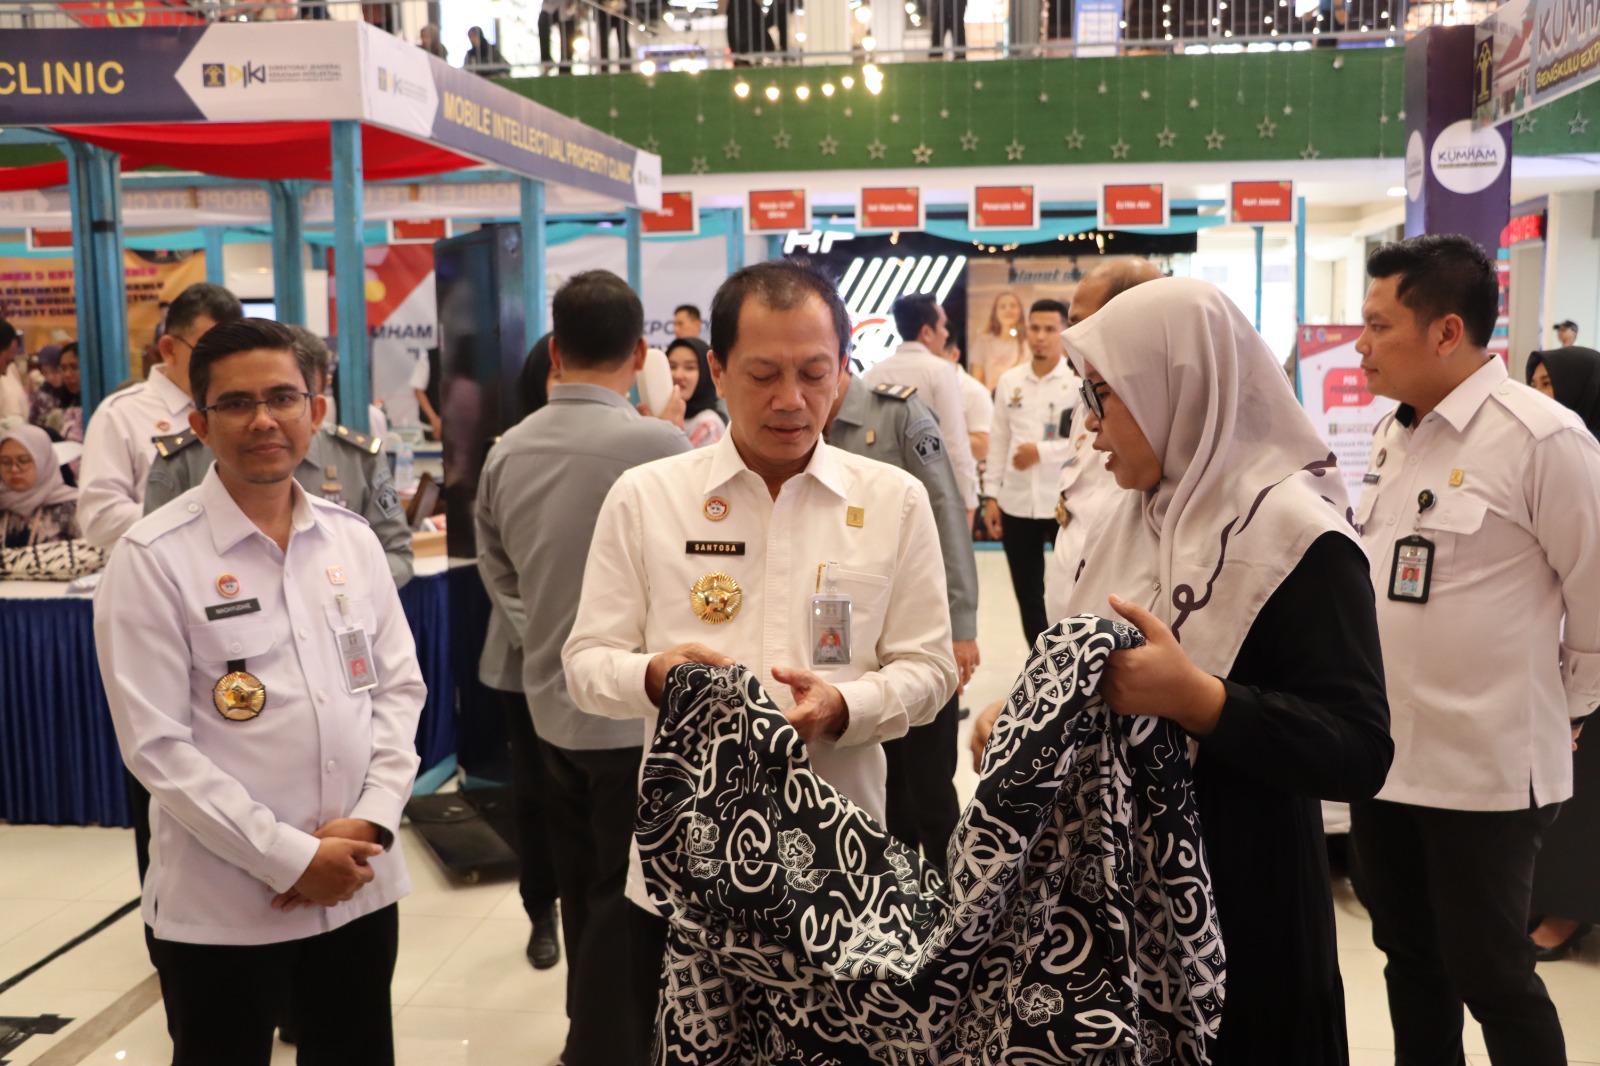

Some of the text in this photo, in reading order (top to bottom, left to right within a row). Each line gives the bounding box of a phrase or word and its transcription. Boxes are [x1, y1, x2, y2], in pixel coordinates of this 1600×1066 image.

[0, 61, 125, 95] CLINIC
[1536, 40, 1600, 90] BENGKULU EXP
[443, 91, 633, 186] MOBILE INTELLECTUAL PROPERTY CLINIC
[1438, 147, 1497, 162] KUMHAM
[694, 543, 737, 553] SANTOSA
